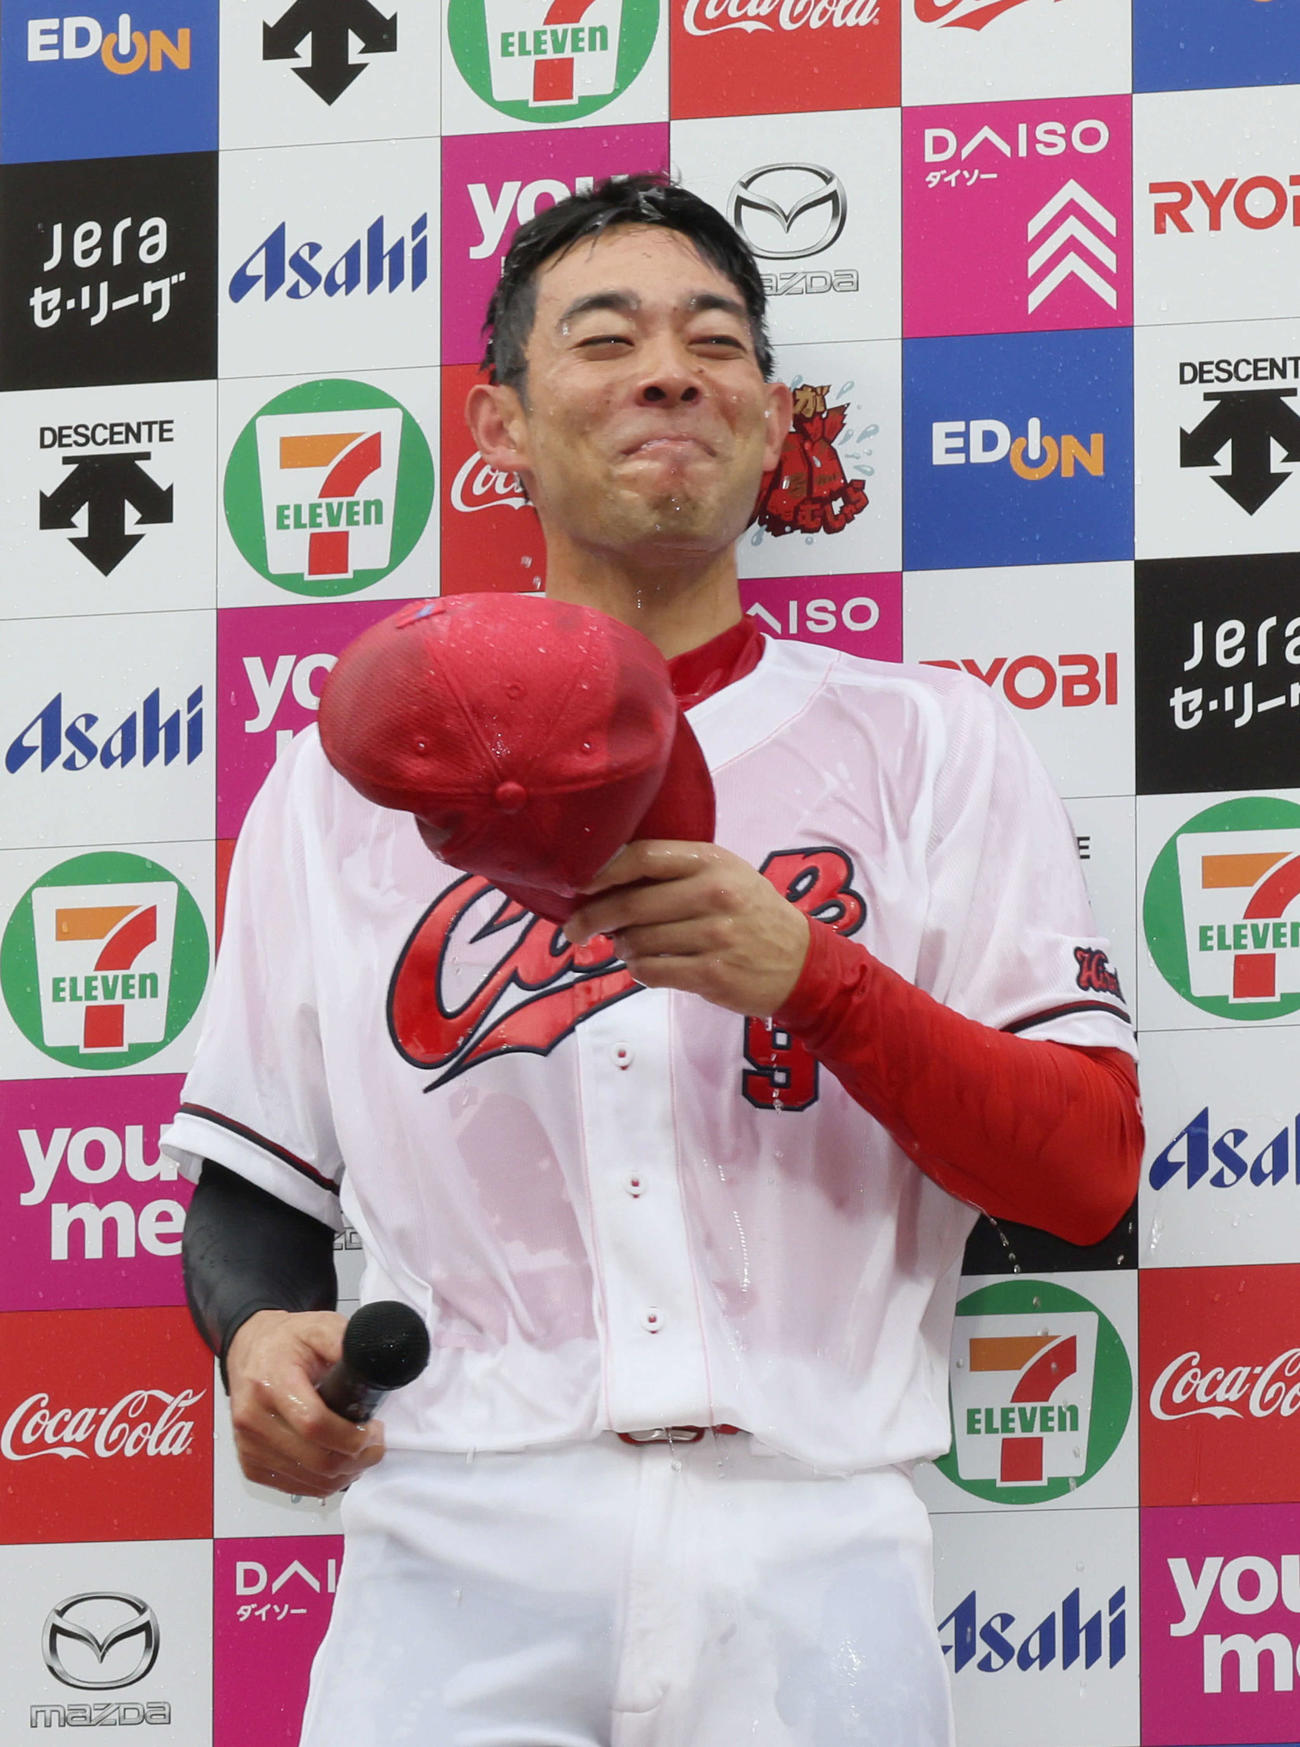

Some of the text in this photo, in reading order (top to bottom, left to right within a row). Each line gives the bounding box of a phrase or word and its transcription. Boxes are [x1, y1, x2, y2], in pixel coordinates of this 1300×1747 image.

[924, 119, 1111, 163] DAISO
[925, 168, 998, 189] ダイソー
[1149, 175, 1300, 235] RYO
[228, 211, 428, 303] Asahi
[29, 272, 186, 328] セ・リーグ
[39, 420, 174, 449] DESCENTE
[5, 684, 203, 774] Asahi
[17, 1124, 179, 1206] you
[51, 1199, 188, 1260] me
[0, 1388, 207, 1461] Coca-Cola
[236, 1603, 308, 1622] ダイソー
[937, 1586, 1126, 1674] Asahi
